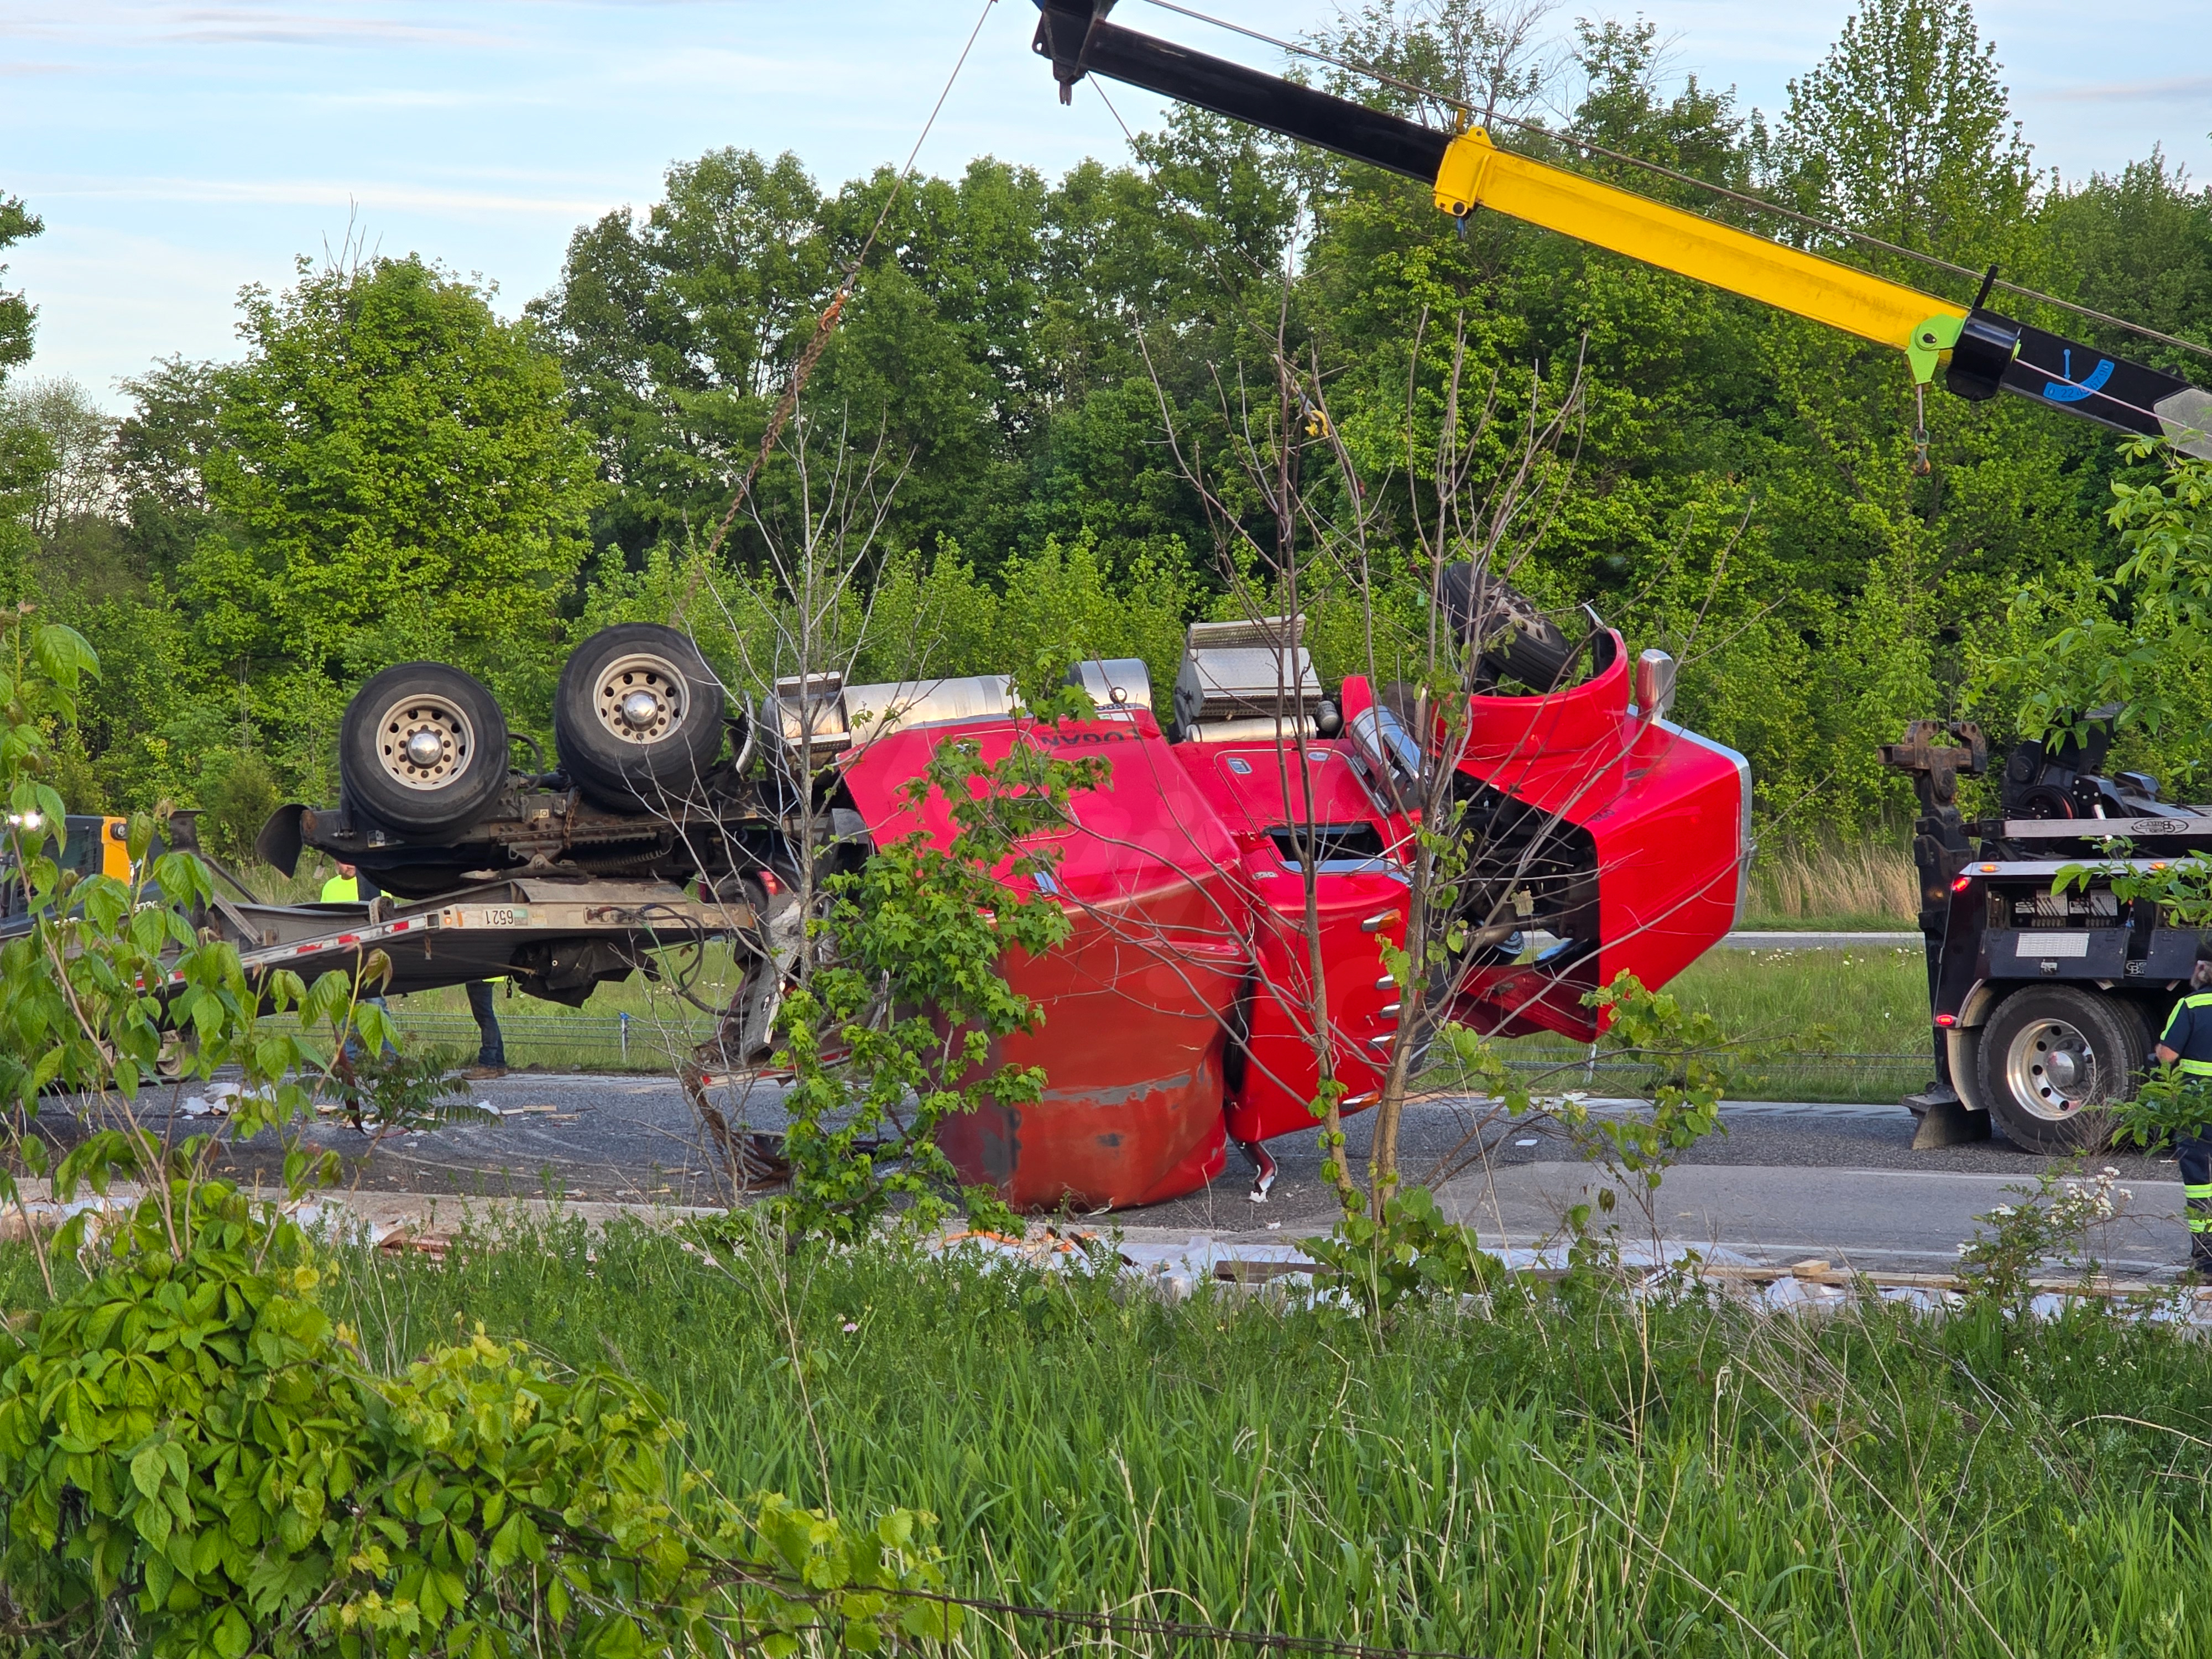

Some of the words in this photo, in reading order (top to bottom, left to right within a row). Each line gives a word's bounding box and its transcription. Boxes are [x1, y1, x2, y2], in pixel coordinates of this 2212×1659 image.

[2048, 387, 2056, 396] 0
[2061, 389, 2074, 398] 22
[2090, 376, 2102, 389] 67
[2099, 363, 2110, 377] 90
[486, 910, 514, 925] 6521
